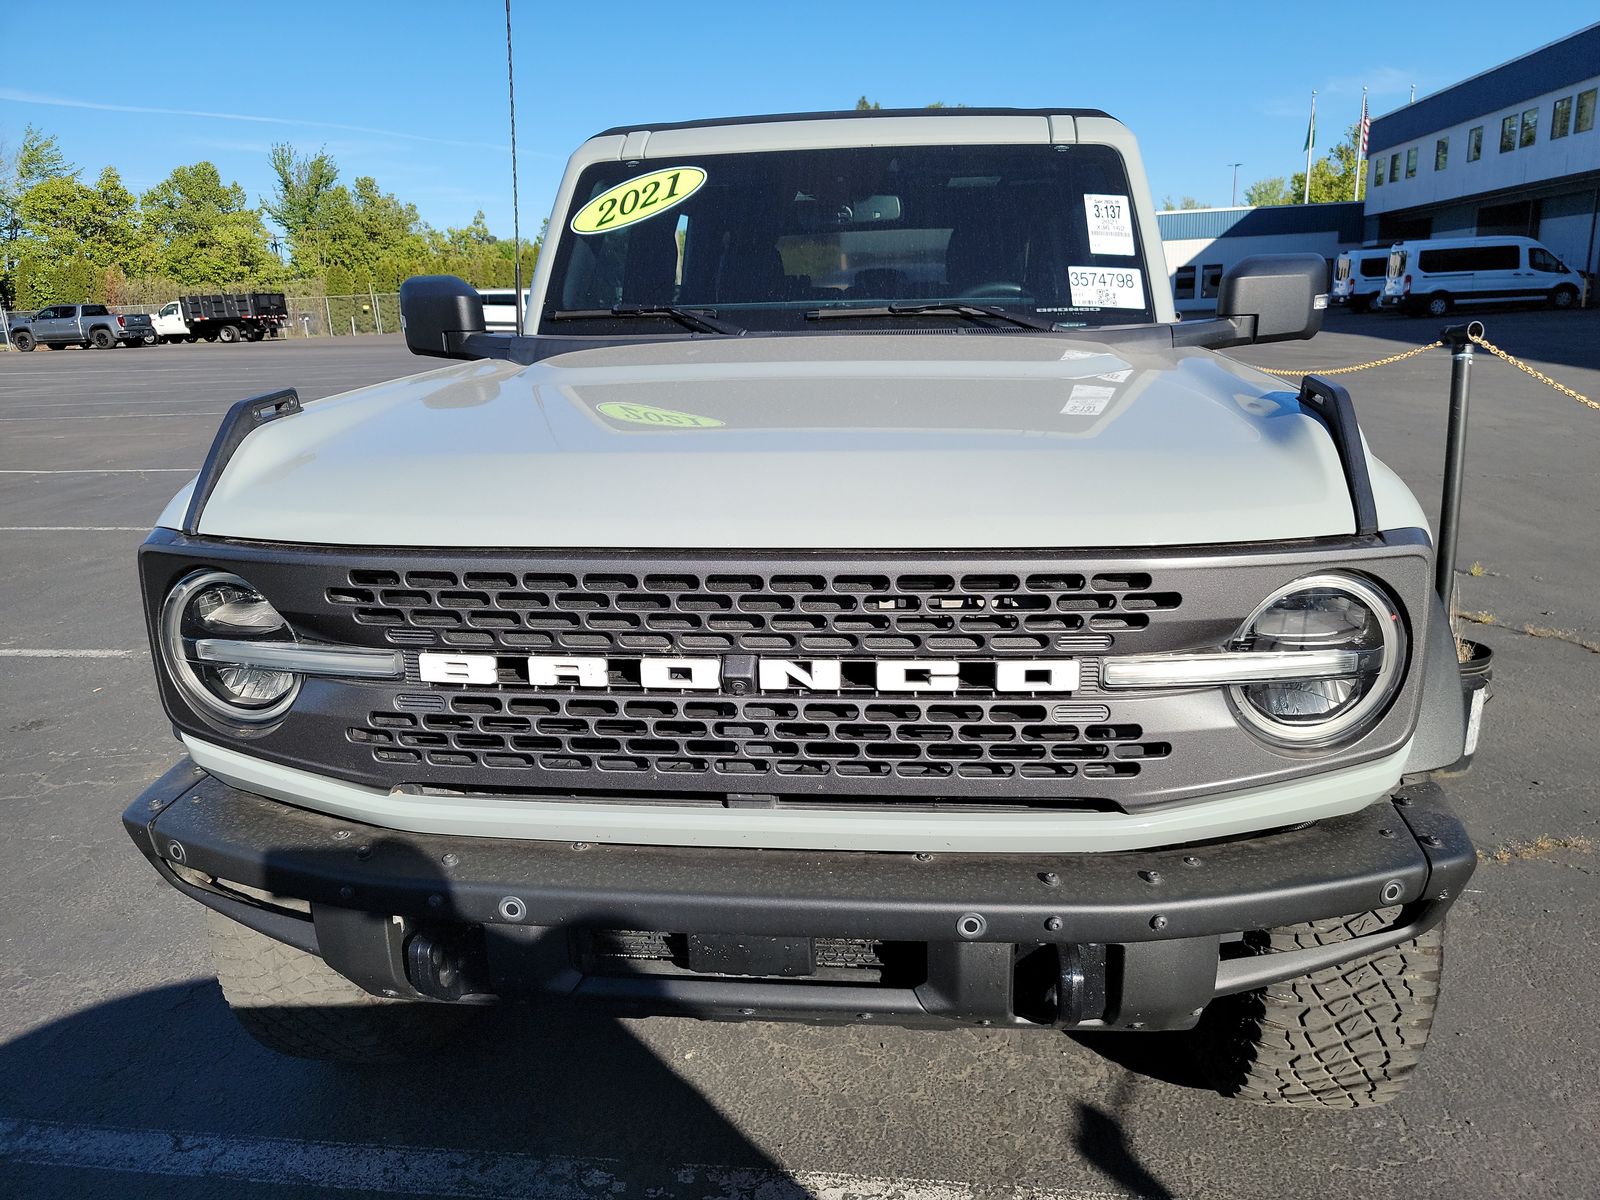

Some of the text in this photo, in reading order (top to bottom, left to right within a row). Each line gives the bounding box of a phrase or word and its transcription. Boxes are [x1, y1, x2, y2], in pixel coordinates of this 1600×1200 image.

[596, 172, 681, 228] 2021
[1093, 204, 1121, 219] 3:137
[1070, 271, 1135, 289] 3574798
[419, 652, 1080, 692] BRONCO
